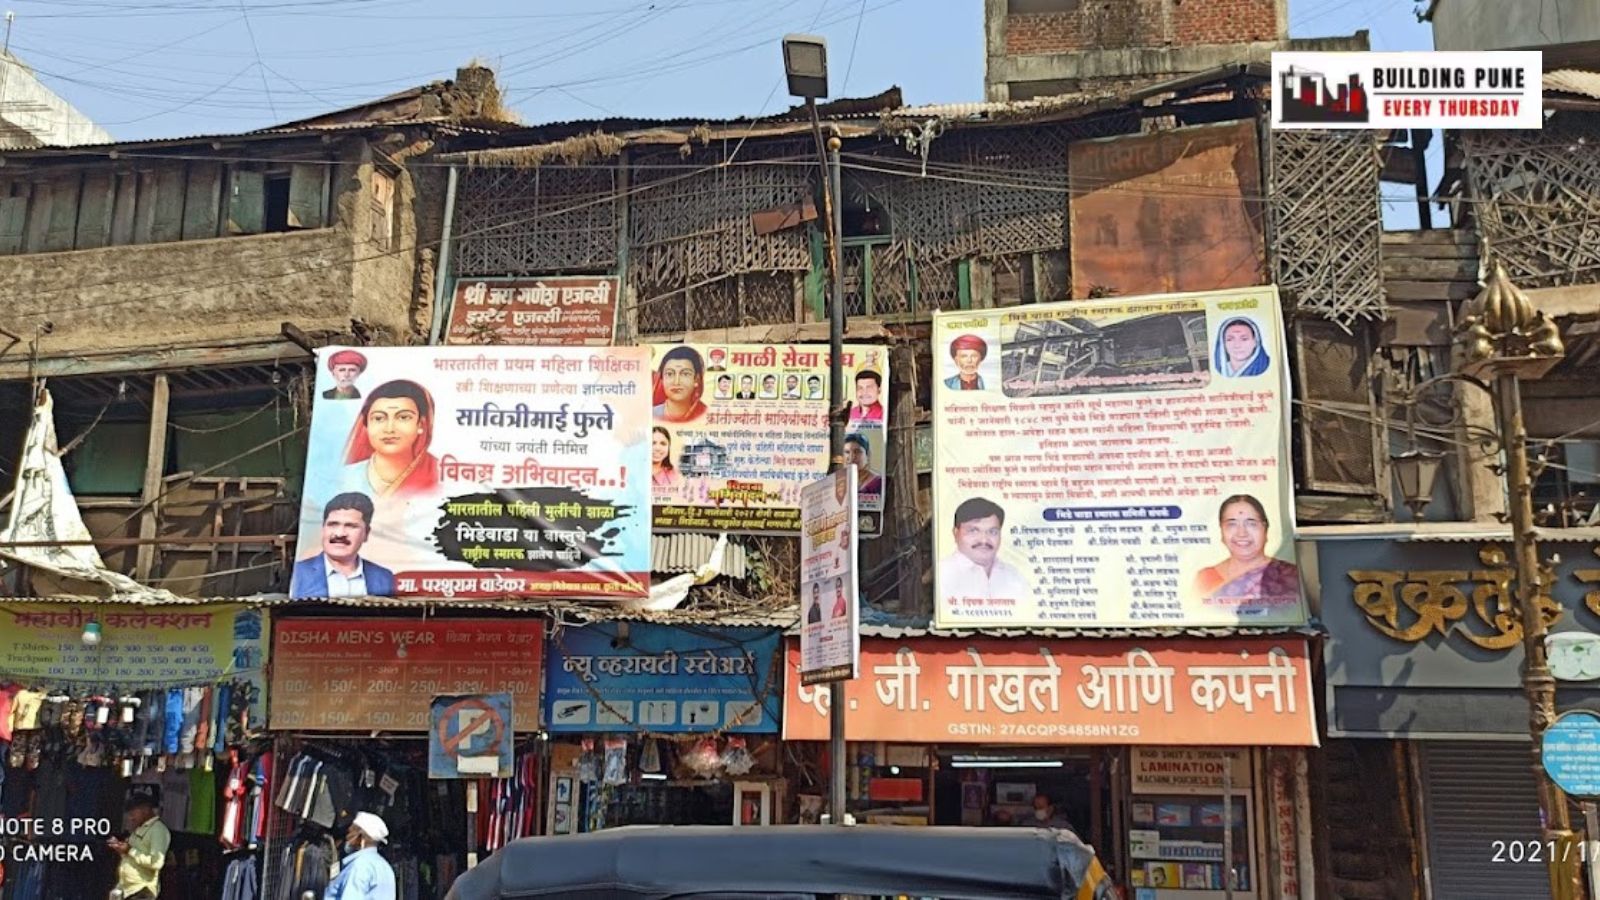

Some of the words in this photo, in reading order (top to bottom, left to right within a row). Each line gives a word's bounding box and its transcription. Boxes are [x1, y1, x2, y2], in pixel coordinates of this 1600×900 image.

[464, 282, 486, 305] श्री
[488, 287, 514, 305] जय
[517, 282, 559, 307] गणेश
[561, 281, 611, 306] एजन्सी
[466, 308, 509, 325] इस्टेट
[512, 307, 561, 326] एजन्सी
[434, 354, 498, 371] भारतातील
[505, 358, 534, 372] प्रथम
[541, 355, 581, 373] महिला
[589, 355, 640, 373] शिक्षिका
[731, 347, 776, 368] माळी
[782, 346, 819, 368] सेवा
[479, 379, 535, 394] शिक्षणाच्या
[573, 404, 614, 438] फुले
[480, 437, 510, 453] यांच्या
[516, 438, 548, 454] जयंती
[553, 441, 588, 455] निमित्त
[438, 454, 494, 484] विनम्र
[502, 457, 627, 488] अभिवादन..!
[447, 500, 502, 517] भारतातील
[507, 500, 540, 517] पहिली
[544, 501, 581, 522] मुलींची
[586, 506, 615, 519] शाळा
[455, 521, 518, 542] भिडेवाडा
[523, 530, 539, 542] या
[397, 578, 418, 593] मा.
[422, 578, 476, 596] परशुराम
[480, 573, 527, 592] वाडेकर
[105, 610, 213, 630] कलेक्शन
[280, 631, 330, 644] DISHA
[336, 631, 384, 644] MEN'S
[390, 631, 435, 644] WEAR
[563, 655, 598, 682] न्यू
[598, 649, 679, 675] व्हरायटी
[322, 680, 357, 693] 150/-
[368, 680, 403, 693] 200/-
[410, 680, 446, 693] 250/-
[874, 647, 930, 712] जी.
[946, 647, 1062, 713] गोखले
[1077, 646, 1174, 713] आणि
[1188, 646, 1298, 713] कंपनी
[948, 723, 995, 736] GSTIN:
[1140, 762, 1224, 773] LAMINATION
